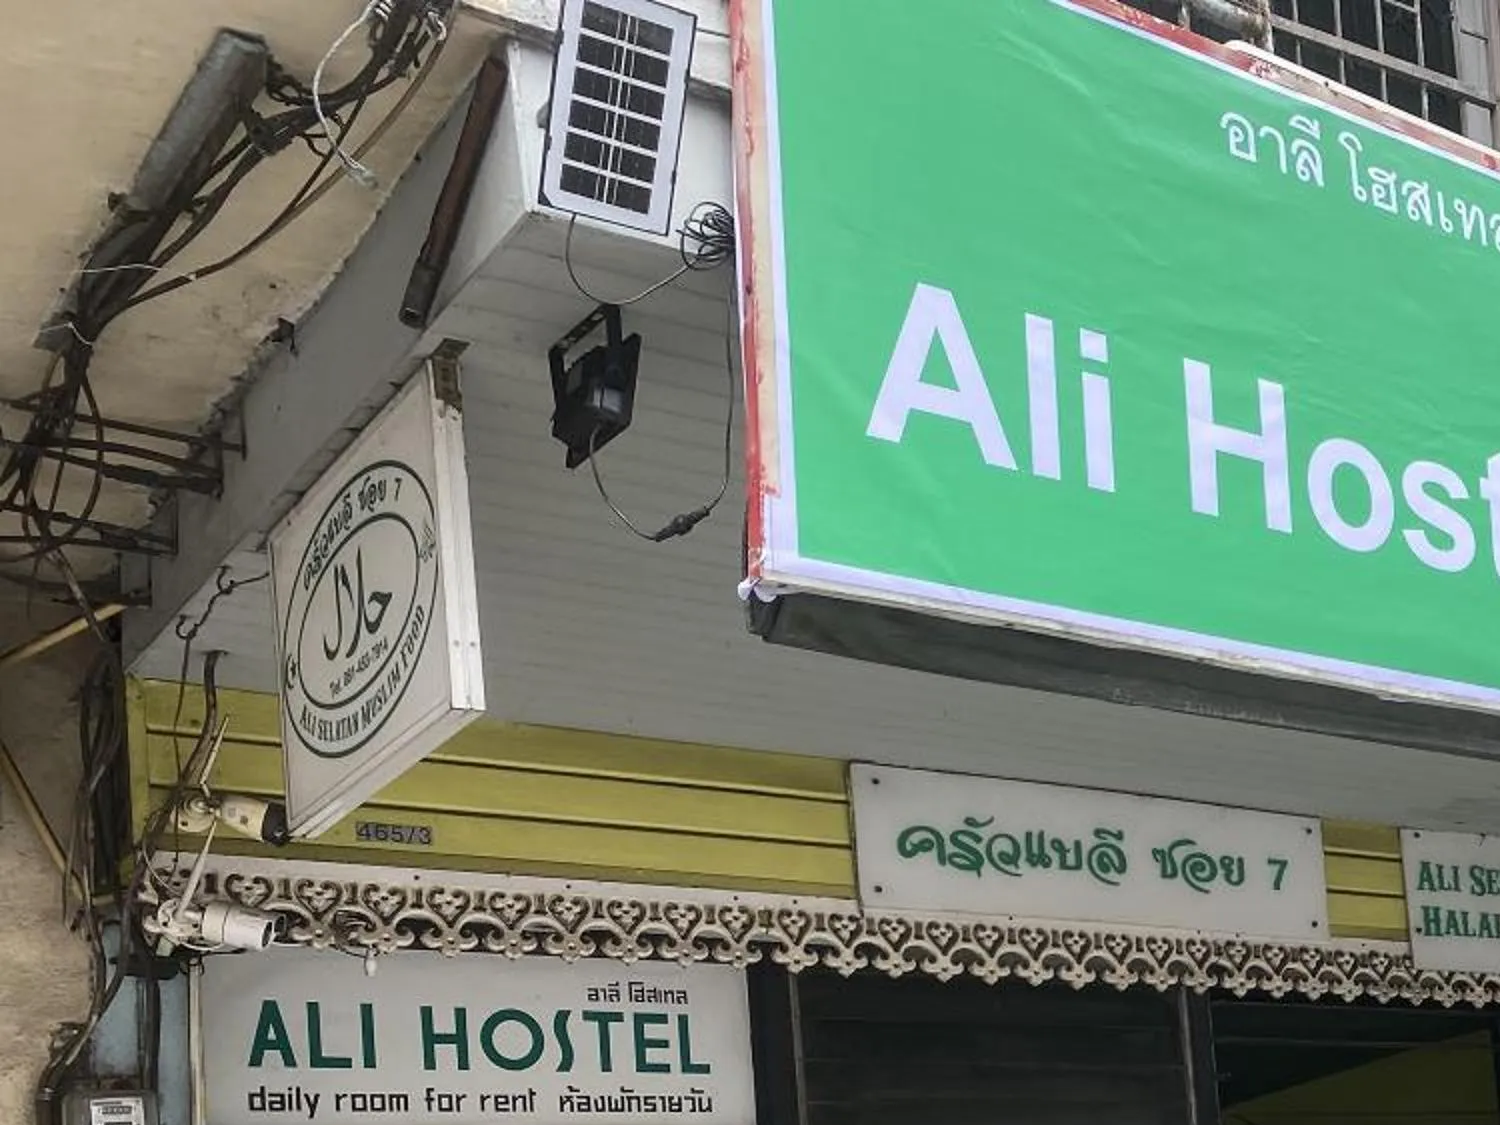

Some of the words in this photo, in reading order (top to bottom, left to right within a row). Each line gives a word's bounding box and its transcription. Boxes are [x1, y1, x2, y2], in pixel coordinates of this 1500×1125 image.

[1220, 111, 1325, 188] อาลี
[866, 281, 1115, 492] Ali
[395, 477, 402, 500] 7
[323, 545, 393, 661] حلال
[300, 705, 317, 736] ALI
[317, 711, 359, 742] SELATAN
[361, 662, 401, 729] MUSLIM
[400, 605, 424, 668] FOOD
[357, 822, 432, 845] 465/3
[896, 816, 1127, 886] ครัวแบลี
[1152, 838, 1246, 892] ซอย
[1268, 859, 1288, 890] 7
[1417, 861, 1461, 892] ALI
[587, 981, 621, 1002] อาลี
[628, 981, 688, 1005] โฮสเทล
[248, 999, 377, 1069] ALI
[420, 1005, 711, 1074] HOSTEL
[248, 1086, 320, 1119] daily
[335, 1092, 409, 1113] room
[425, 1087, 467, 1113] for
[480, 1088, 538, 1113] rent
[559, 1086, 713, 1113] ห้องพักรายวัน
